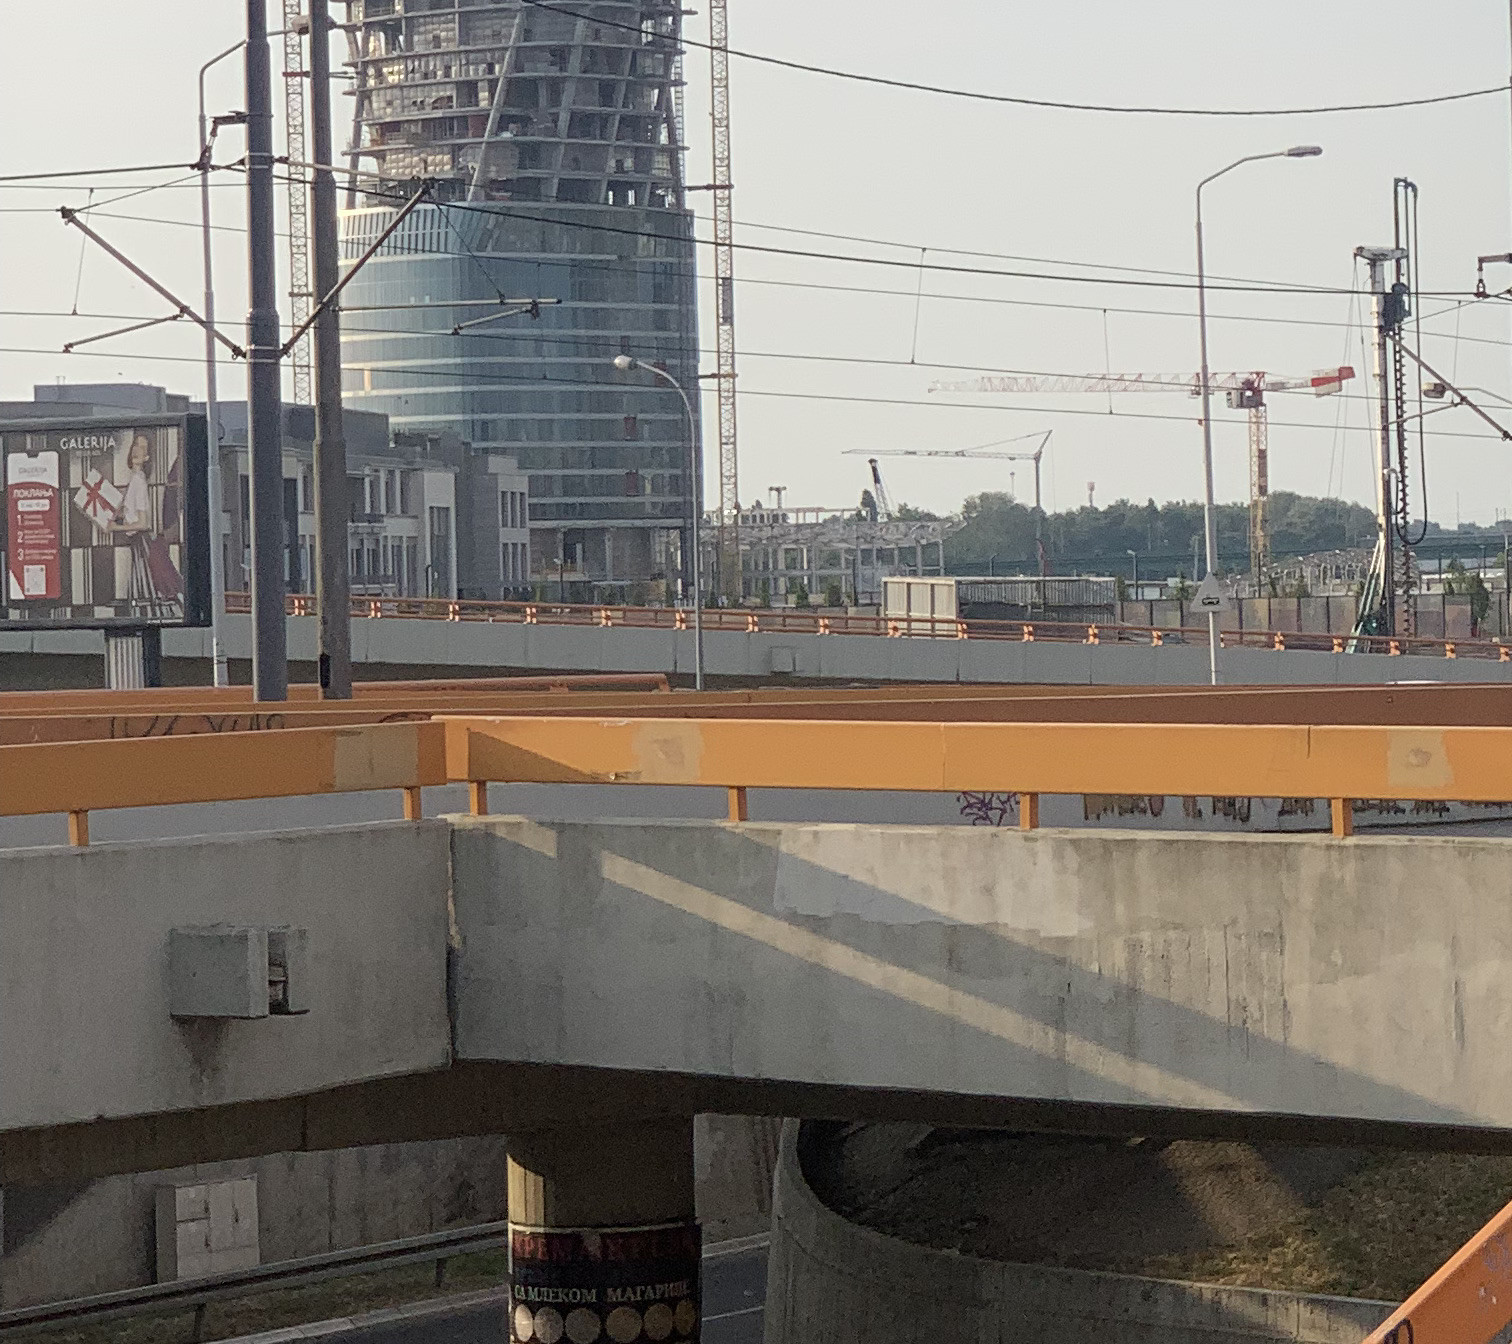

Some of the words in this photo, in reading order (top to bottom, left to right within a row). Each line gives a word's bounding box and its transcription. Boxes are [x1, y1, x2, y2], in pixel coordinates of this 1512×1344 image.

[60, 436, 116, 452] GALERIJA
[17, 514, 22, 526] 1
[17, 531, 24, 543] 2
[17, 549, 24, 561] 3
